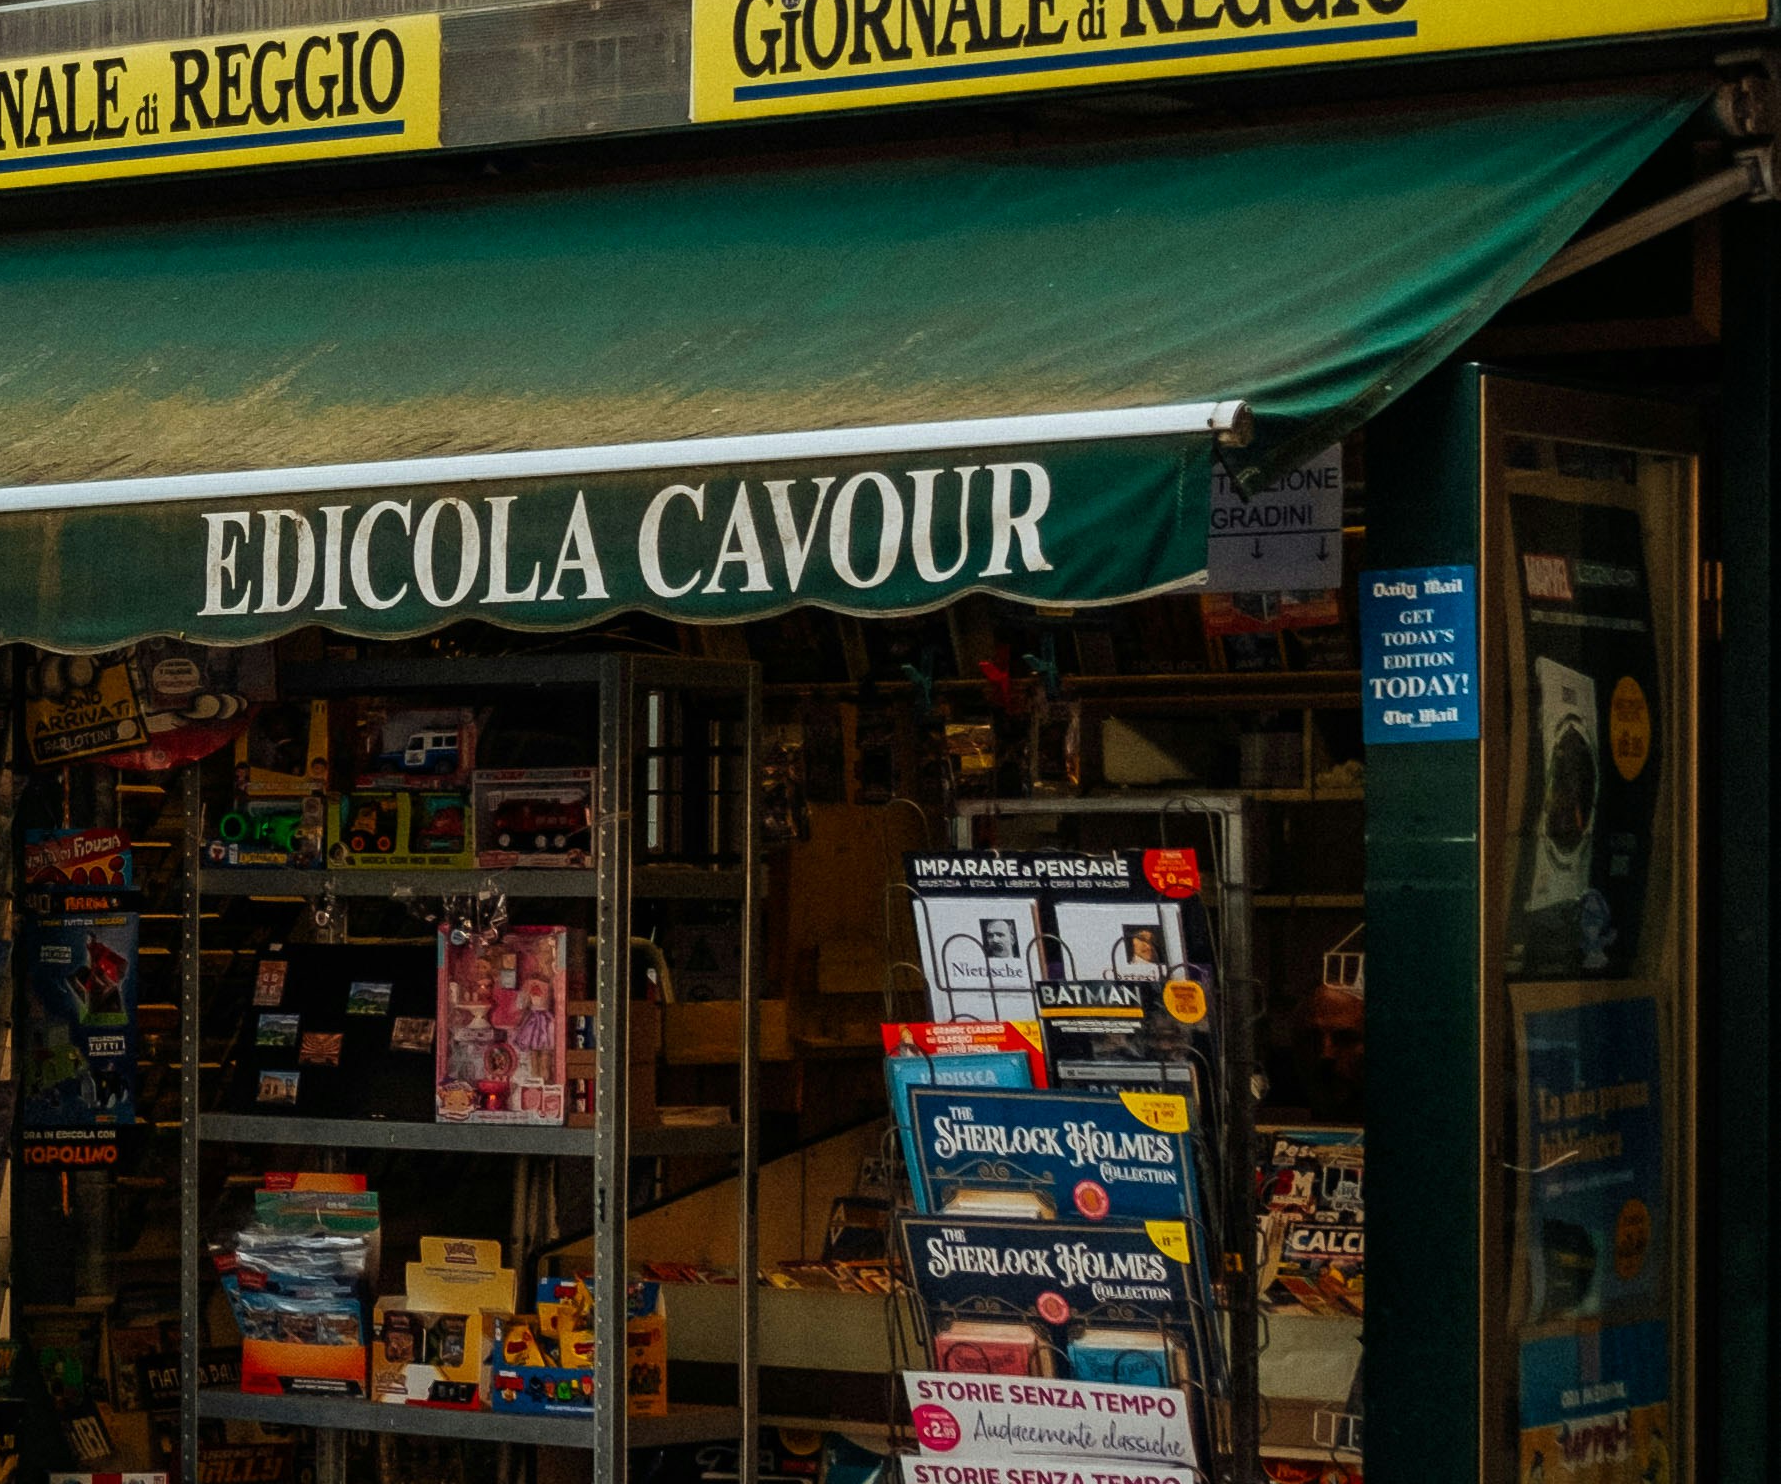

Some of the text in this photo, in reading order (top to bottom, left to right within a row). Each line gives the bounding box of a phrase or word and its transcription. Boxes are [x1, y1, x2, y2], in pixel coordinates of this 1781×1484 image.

[135, 94, 159, 136] di
[169, 28, 405, 132] REGGIO
[1211, 505, 1313, 529] GRADINI
[197, 461, 1054, 616] EDICOLA CAVOUR
[1373, 579, 1463, 599] Daily Mail
[1399, 609, 1434, 625] GET
[1382, 629, 1454, 646] TODAY'S
[1383, 652, 1454, 670] EDITION
[1370, 673, 1469, 699] TODAY!
[914, 859, 1018, 877] IMPARARE
[1034, 859, 1129, 877] PENSARE
[1040, 983, 1142, 1007] BATMAN
[948, 1104, 974, 1123] THE
[933, 1114, 1175, 1168] SHERLOCK HOLMES
[23, 1144, 118, 1165] TOPOLINO
[1099, 1160, 1178, 1185] COLLECTION
[941, 1227, 967, 1244] THE
[926, 1236, 1169, 1288] SHERLOCK HOLMES
[1091, 1280, 1172, 1303] COLLECTION
[917, 1380, 1177, 1418] STORIE SENZA TEMPO
[974, 1410, 1187, 1457] Audacemente classiche
